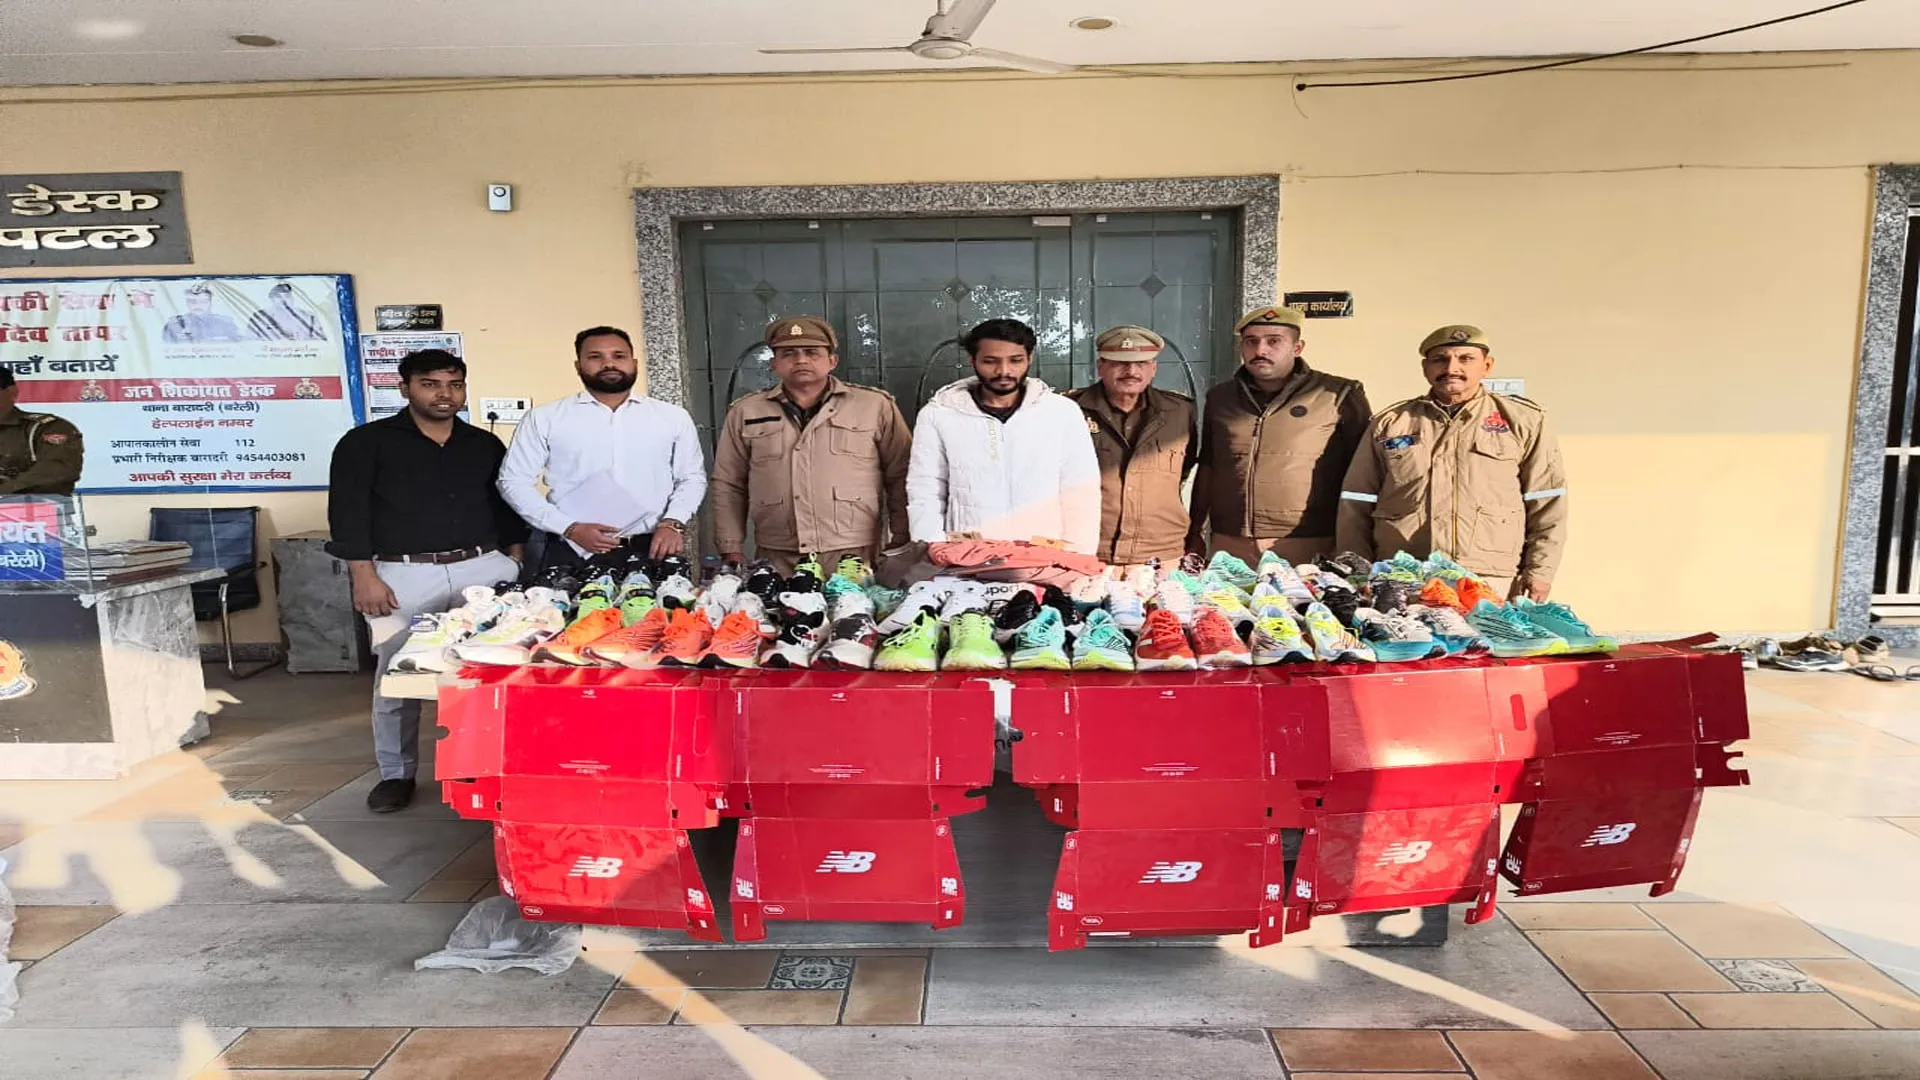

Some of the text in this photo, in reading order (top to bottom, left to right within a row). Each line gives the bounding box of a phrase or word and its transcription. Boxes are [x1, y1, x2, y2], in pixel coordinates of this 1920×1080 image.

[7, 184, 160, 216] डेस्क
[48, 354, 119, 373] बतायें
[122, 385, 153, 398] जन
[236, 439, 255, 447] 112
[1580, 822, 1637, 847] NB
[815, 851, 877, 873] NB
[1373, 841, 1432, 867] NB
[567, 856, 623, 878] NB
[1137, 861, 1202, 884] NB
